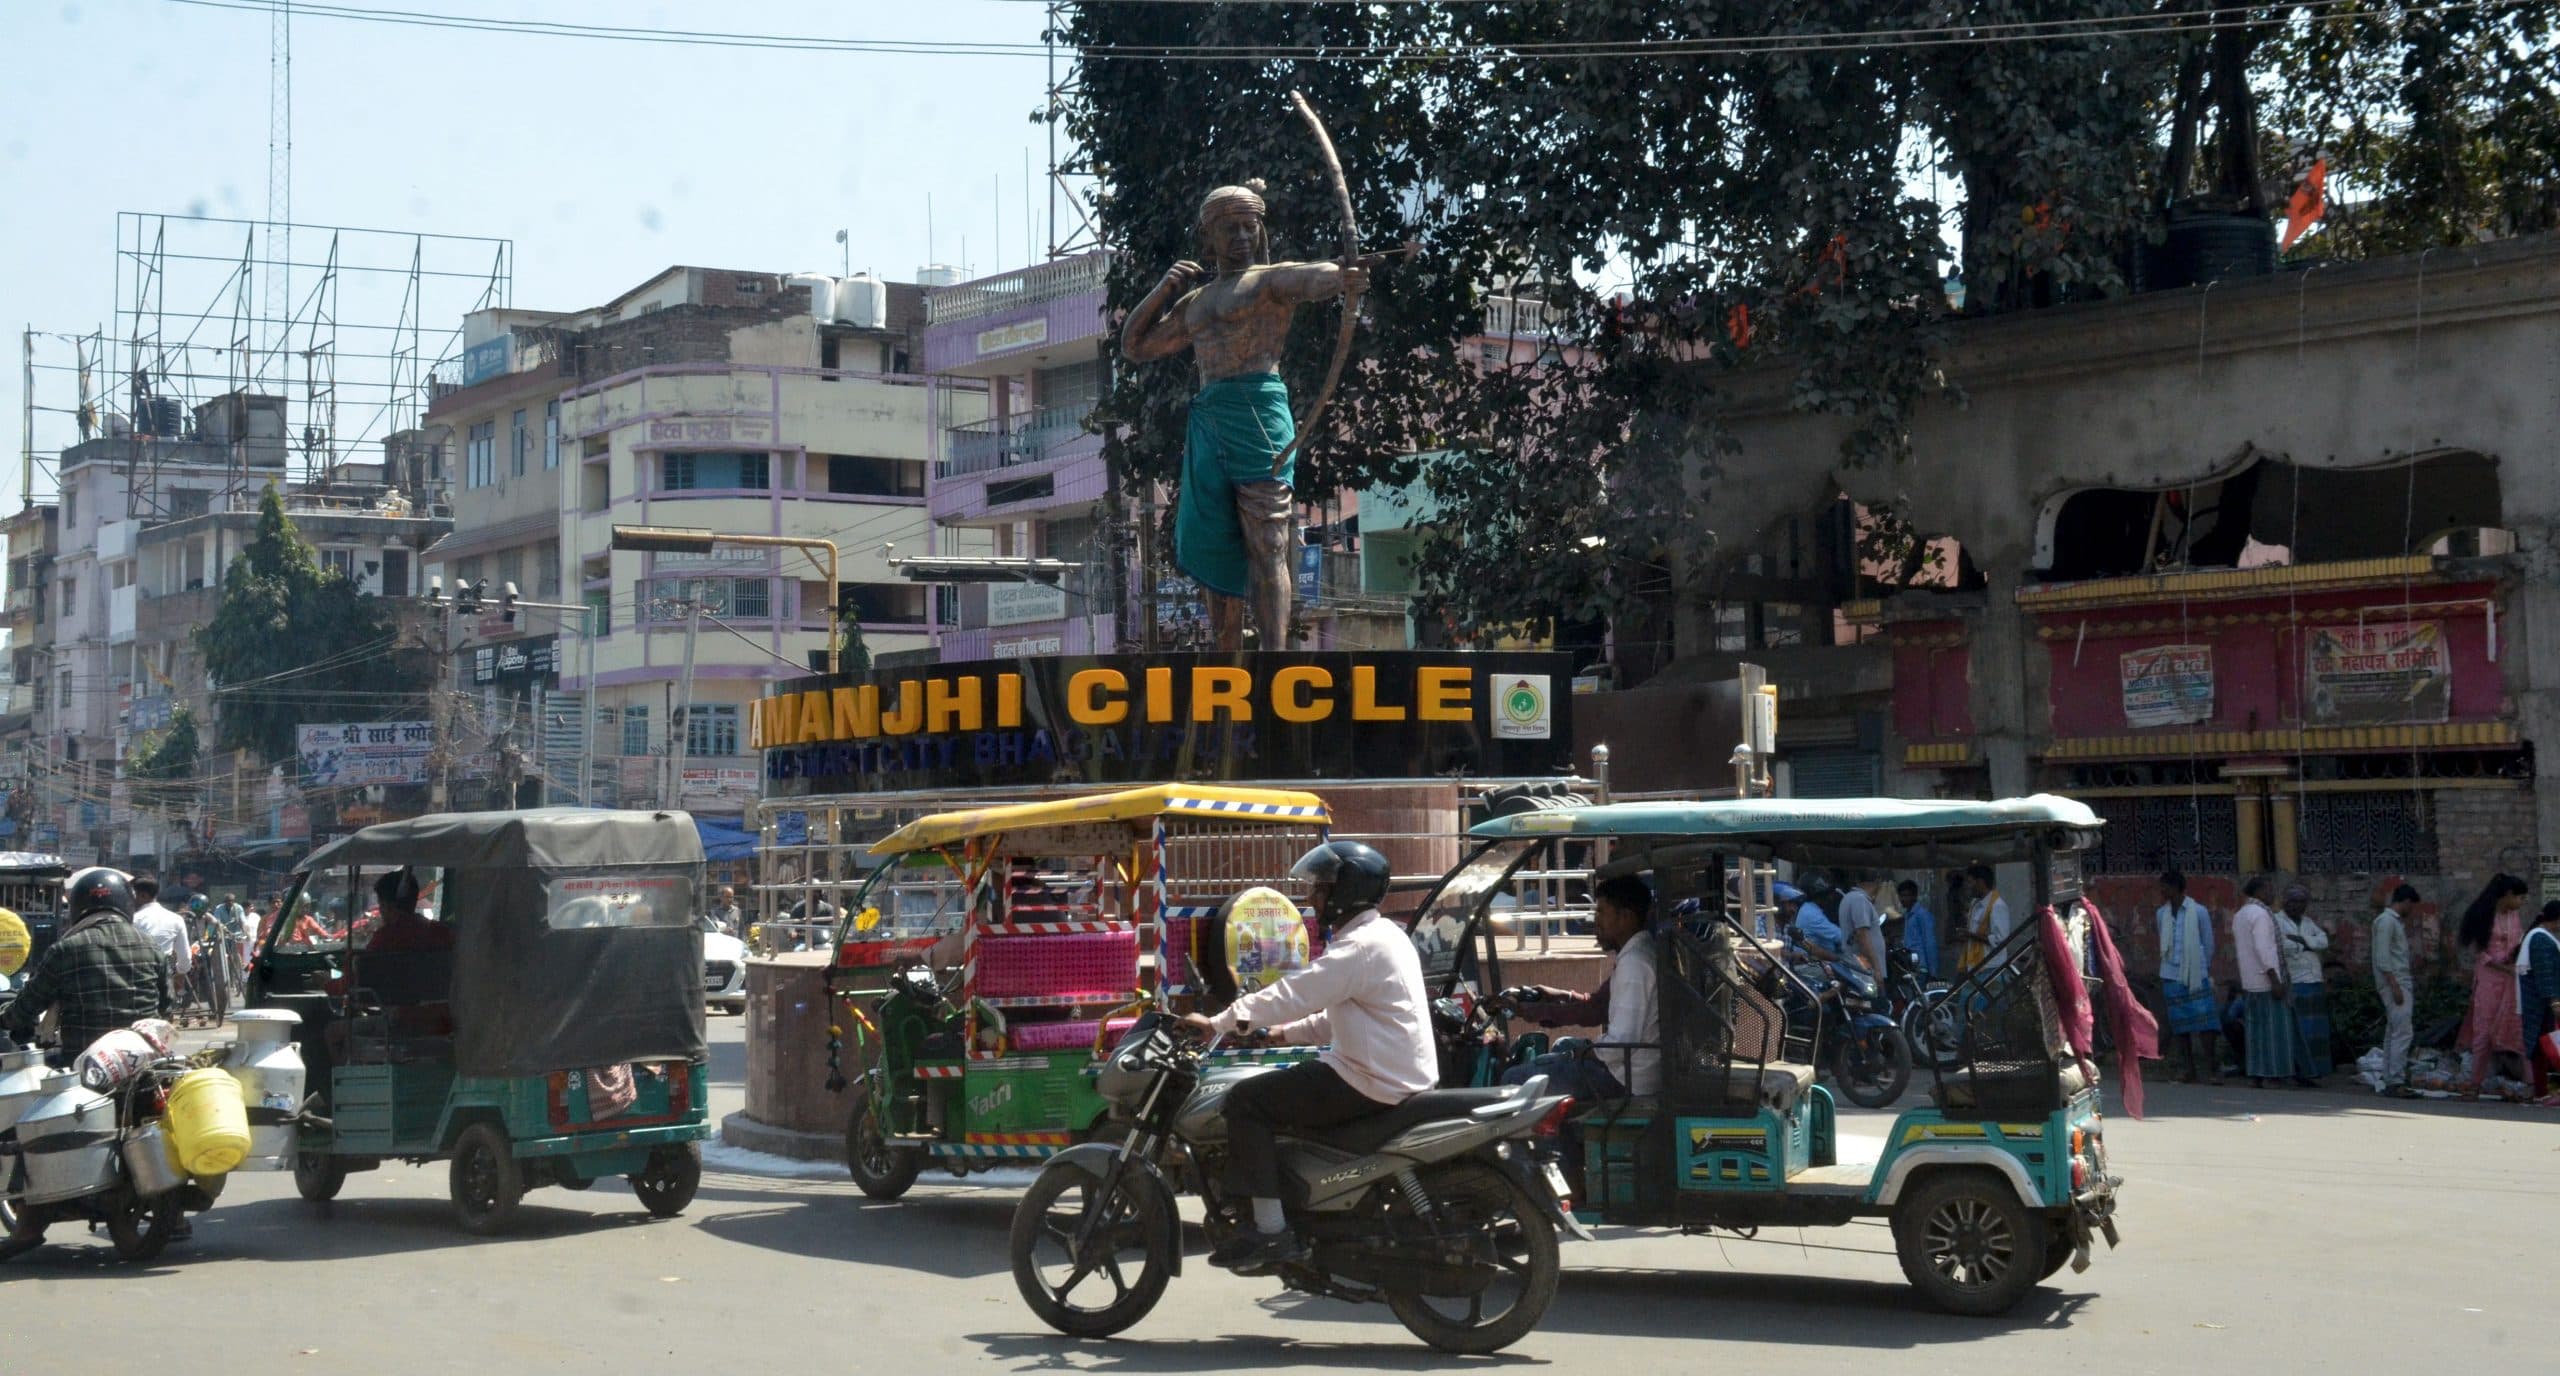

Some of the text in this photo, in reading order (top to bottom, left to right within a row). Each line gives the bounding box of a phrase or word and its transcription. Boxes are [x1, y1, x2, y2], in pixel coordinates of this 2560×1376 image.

[1067, 666, 1473, 724] CIRCLE
[367, 724, 399, 744] साई
[880, 736, 959, 774] CITY
[974, 726, 1258, 767] BHAGALPUR
[1200, 1082, 1227, 1097] TVS
